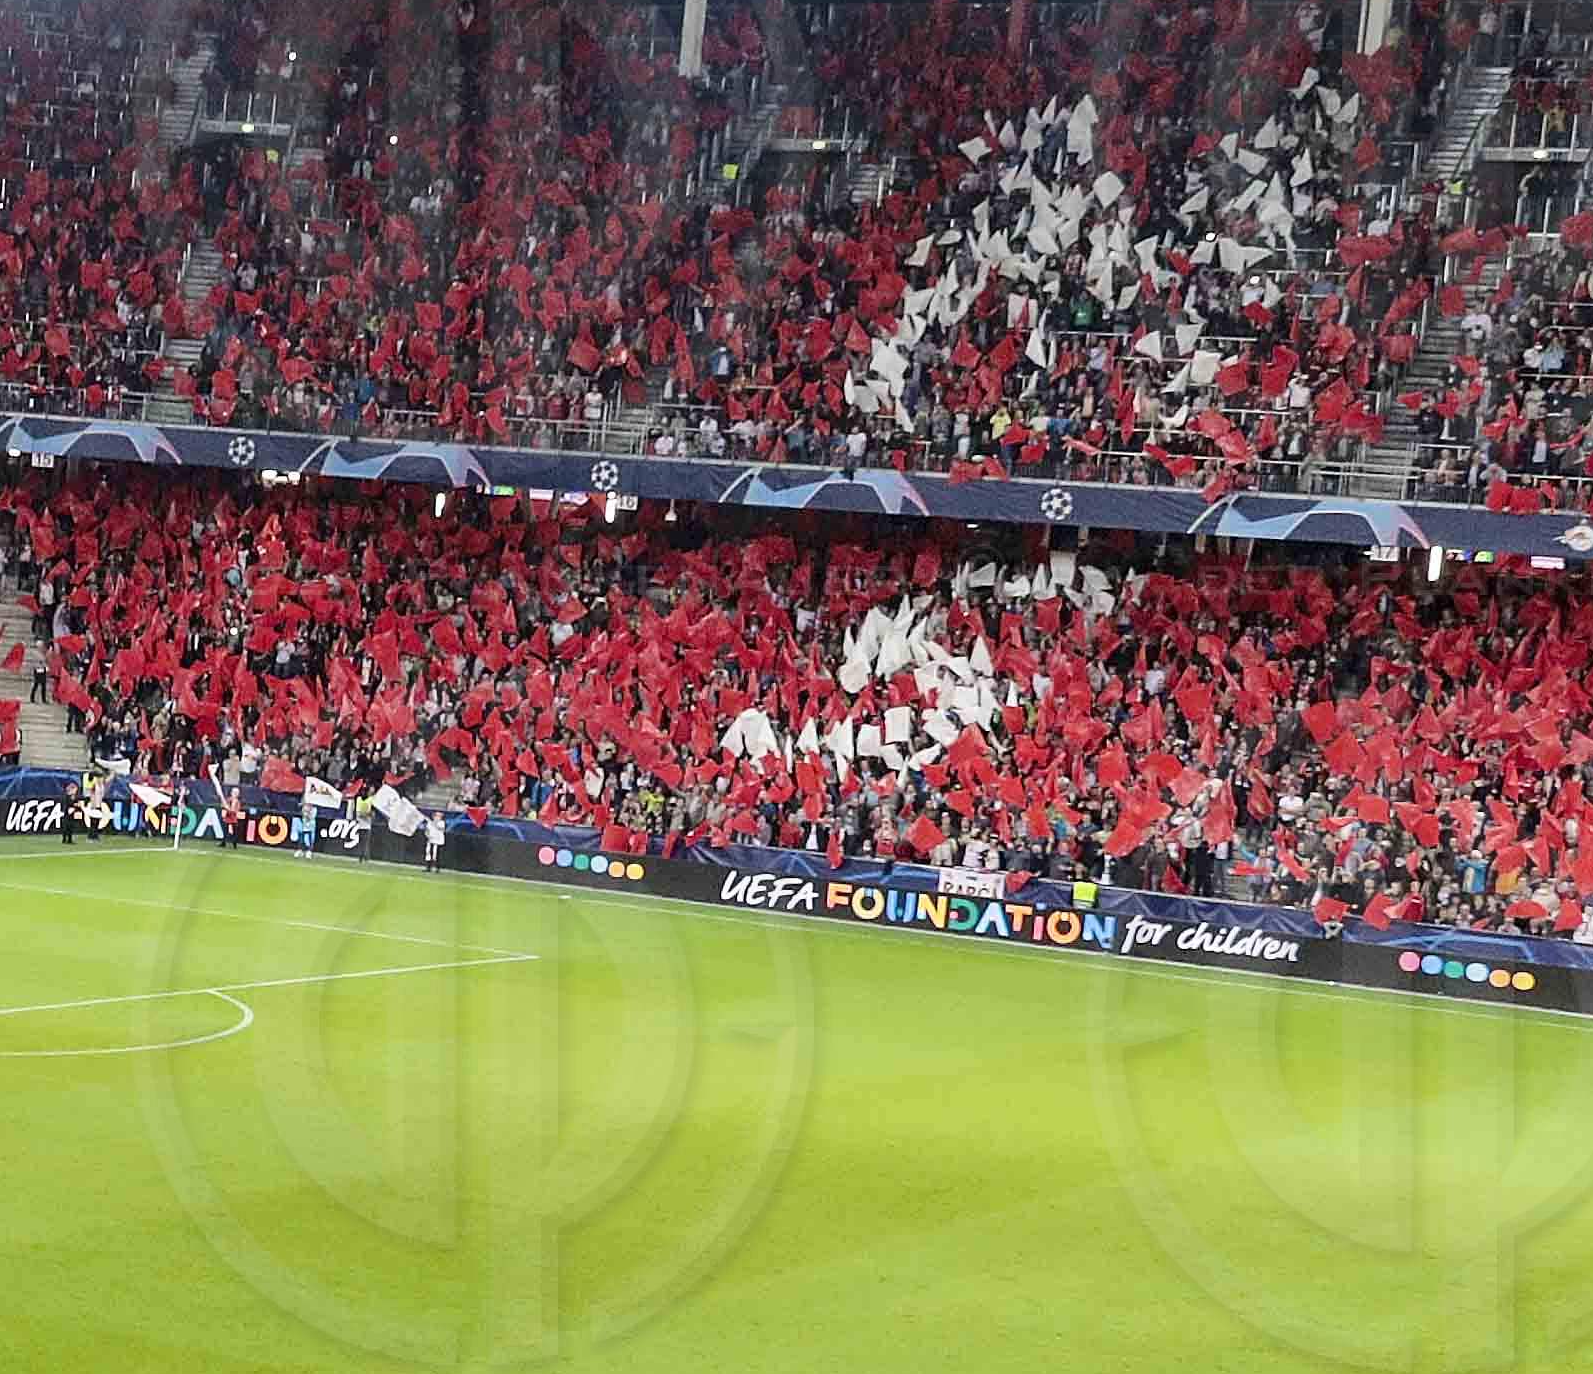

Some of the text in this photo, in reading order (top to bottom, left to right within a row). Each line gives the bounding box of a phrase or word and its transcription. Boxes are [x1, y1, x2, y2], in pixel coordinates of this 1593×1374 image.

[5, 799, 65, 833] UEFA
[719, 867, 819, 910] UEFA
[1124, 913, 1173, 957] for
[1176, 923, 1300, 964] children
